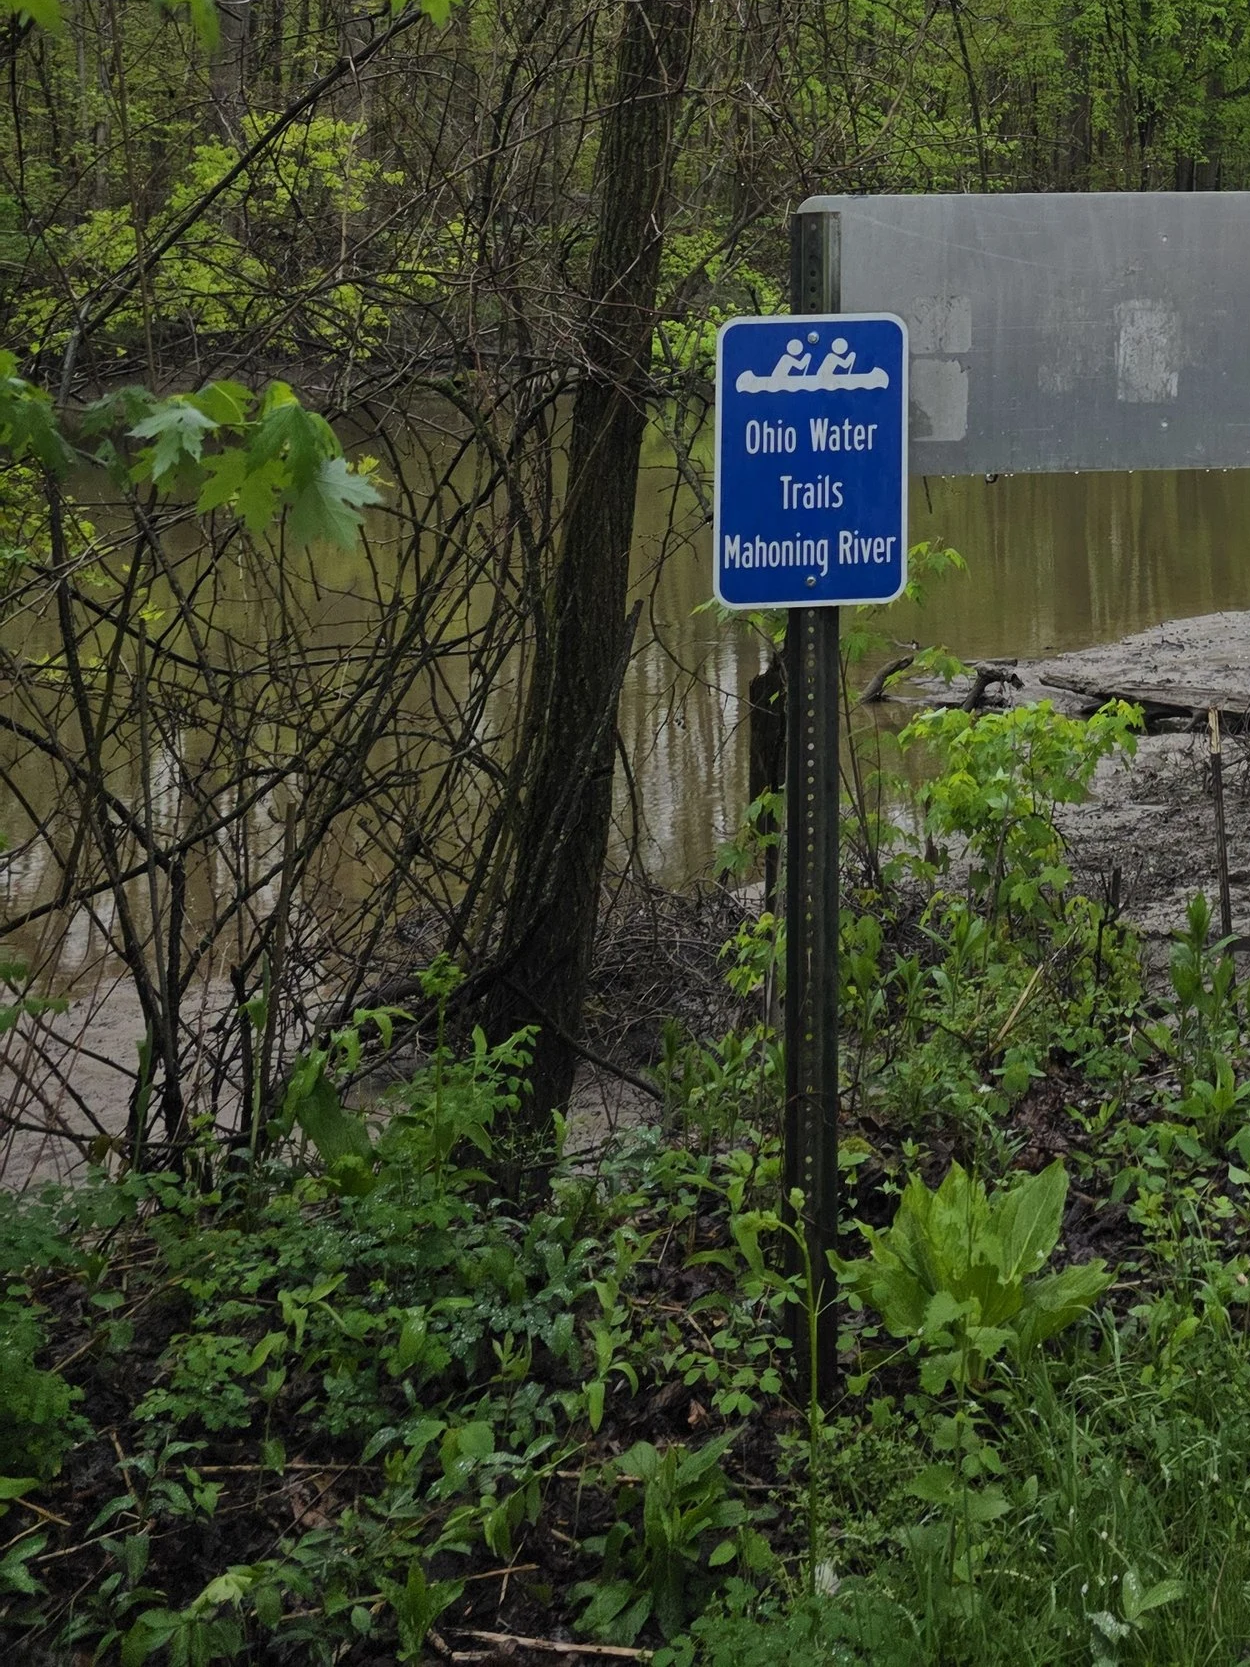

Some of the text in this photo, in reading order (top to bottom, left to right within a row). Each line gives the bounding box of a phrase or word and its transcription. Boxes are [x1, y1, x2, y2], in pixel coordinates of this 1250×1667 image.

[745, 418, 878, 454] Ohio Water
[779, 475, 844, 510] Trails
[724, 530, 896, 577] Mahoning River
